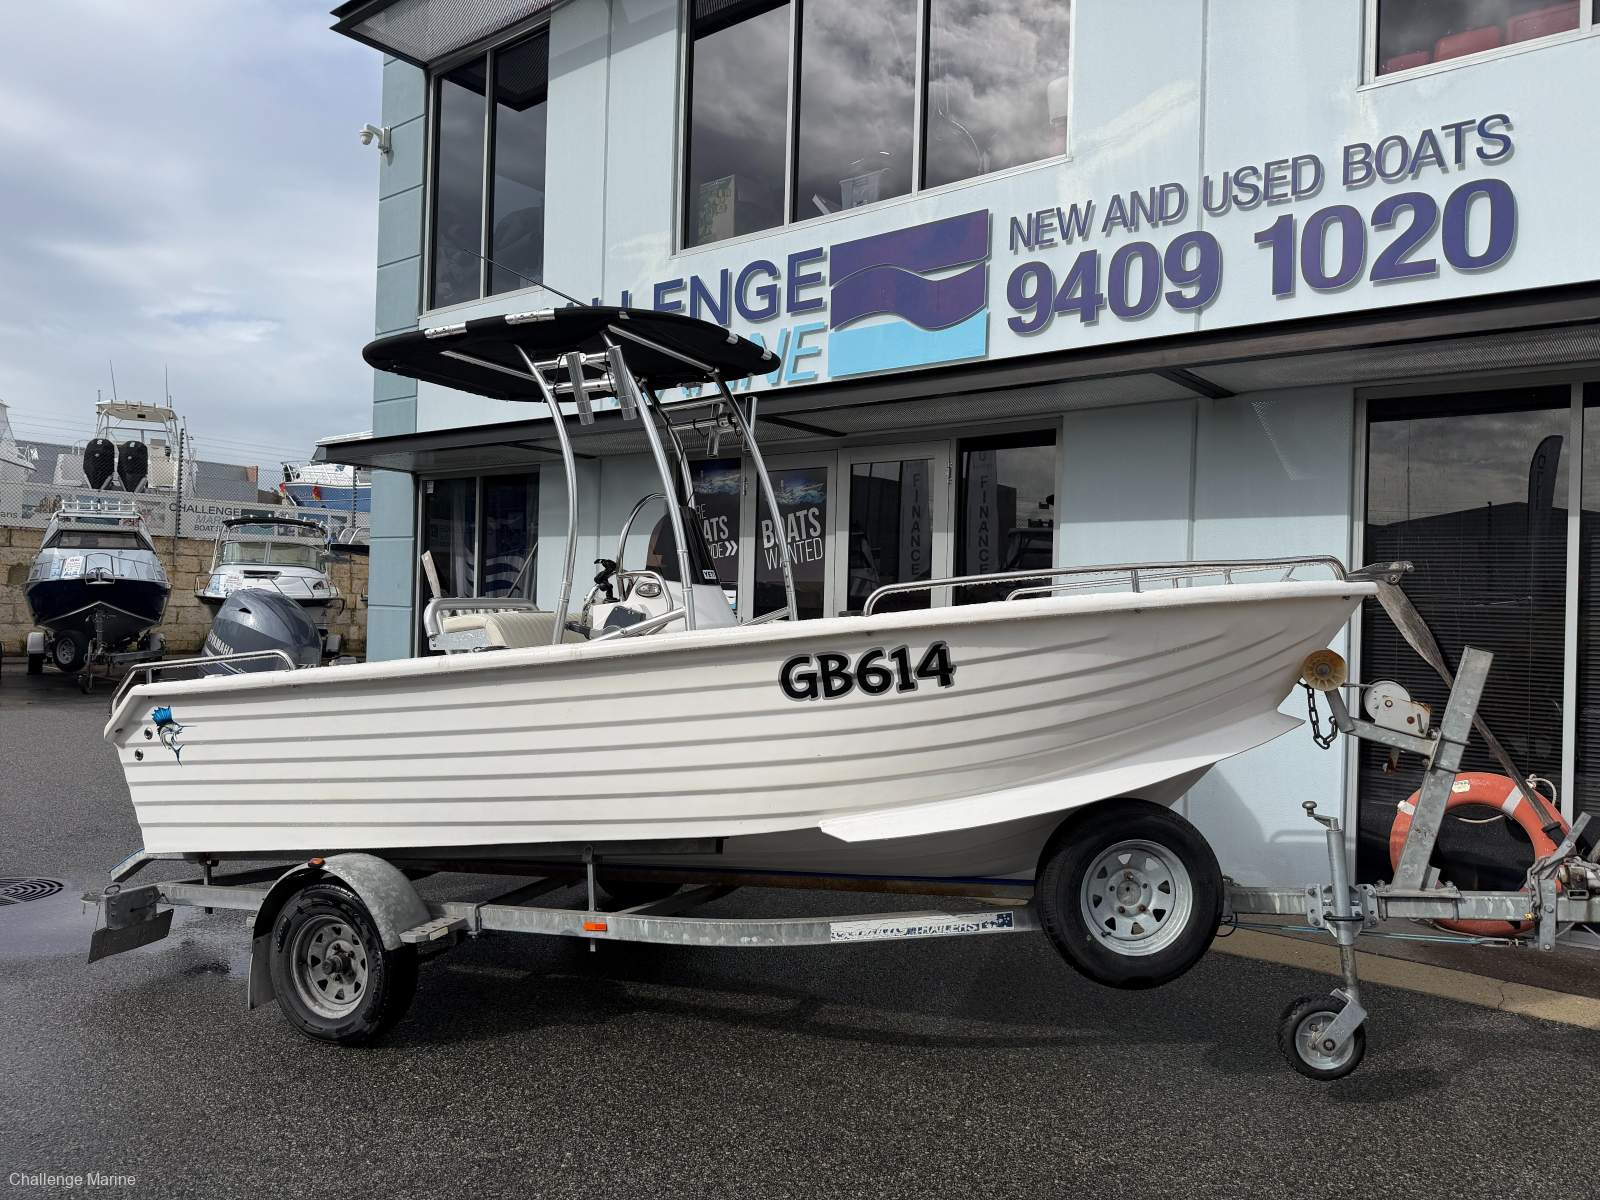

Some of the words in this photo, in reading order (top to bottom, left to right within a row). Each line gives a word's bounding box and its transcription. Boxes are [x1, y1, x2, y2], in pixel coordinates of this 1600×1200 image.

[1010, 200, 1093, 250] NEW
[1101, 182, 1186, 233] AND
[1203, 154, 1322, 212] USED
[1343, 114, 1512, 186] BOATS
[1006, 230, 1223, 334] 9409
[1254, 178, 1516, 296] 1020
[169, 503, 241, 516] CHALLENGE
[194, 524, 214, 532] BOAT
[911, 473, 922, 576] FINANCE
[764, 538, 824, 570] WNTED
[210, 631, 234, 656] YAMAHA
[778, 640, 957, 701] GB614
